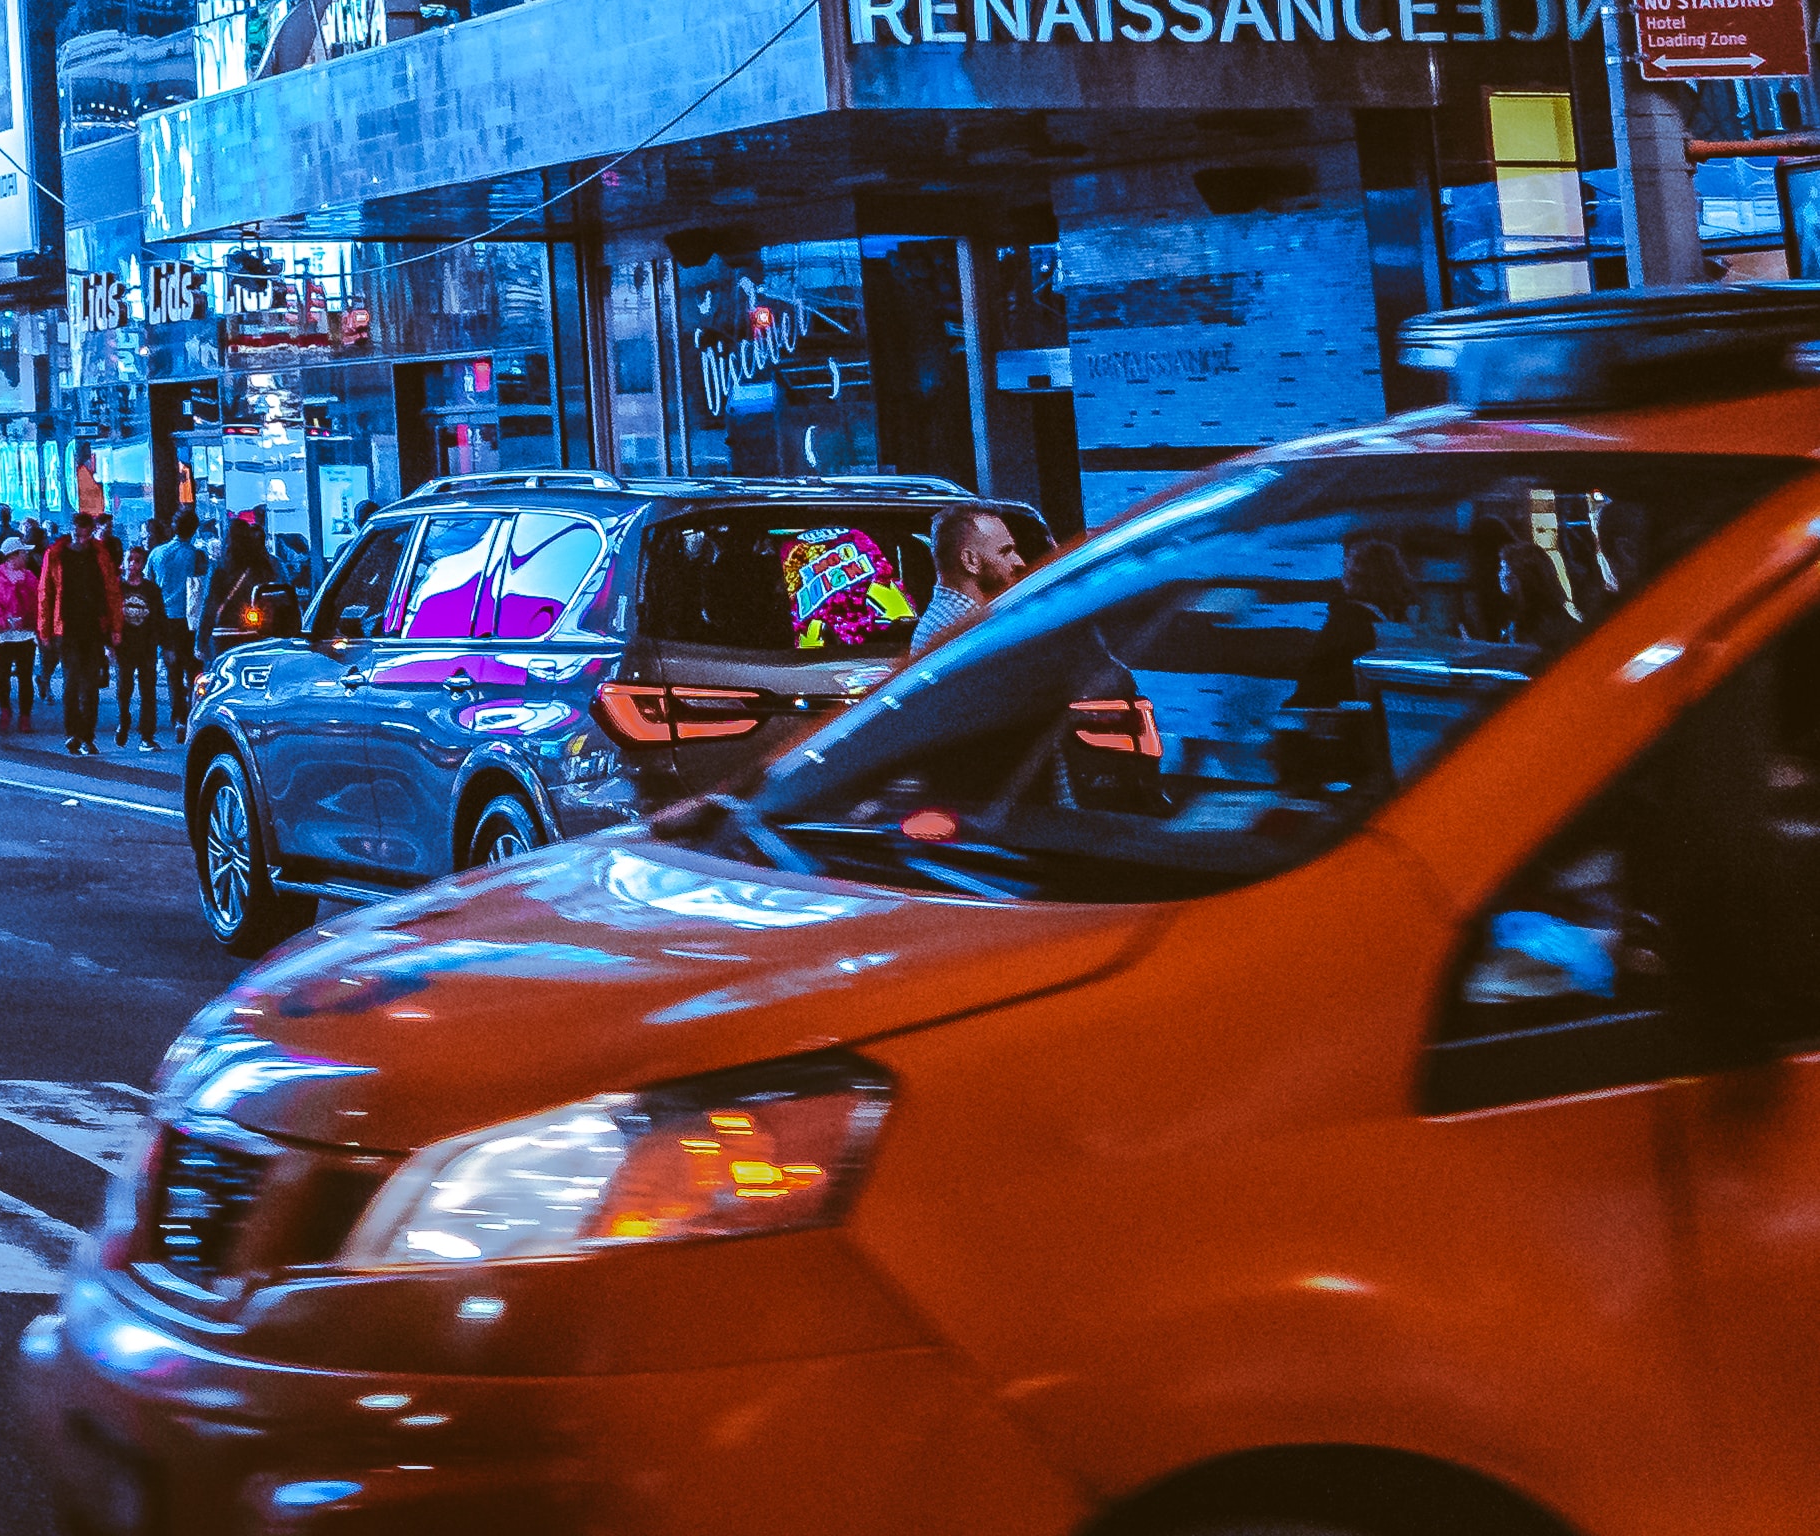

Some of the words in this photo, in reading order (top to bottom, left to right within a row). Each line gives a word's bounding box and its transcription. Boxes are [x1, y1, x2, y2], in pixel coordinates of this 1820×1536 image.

[1646, 15, 1686, 30] Hotel
[1648, 32, 1706, 49] Loading
[1710, 32, 1747, 46] Zone
[77, 272, 121, 332] Lids
[147, 263, 196, 326] Lids
